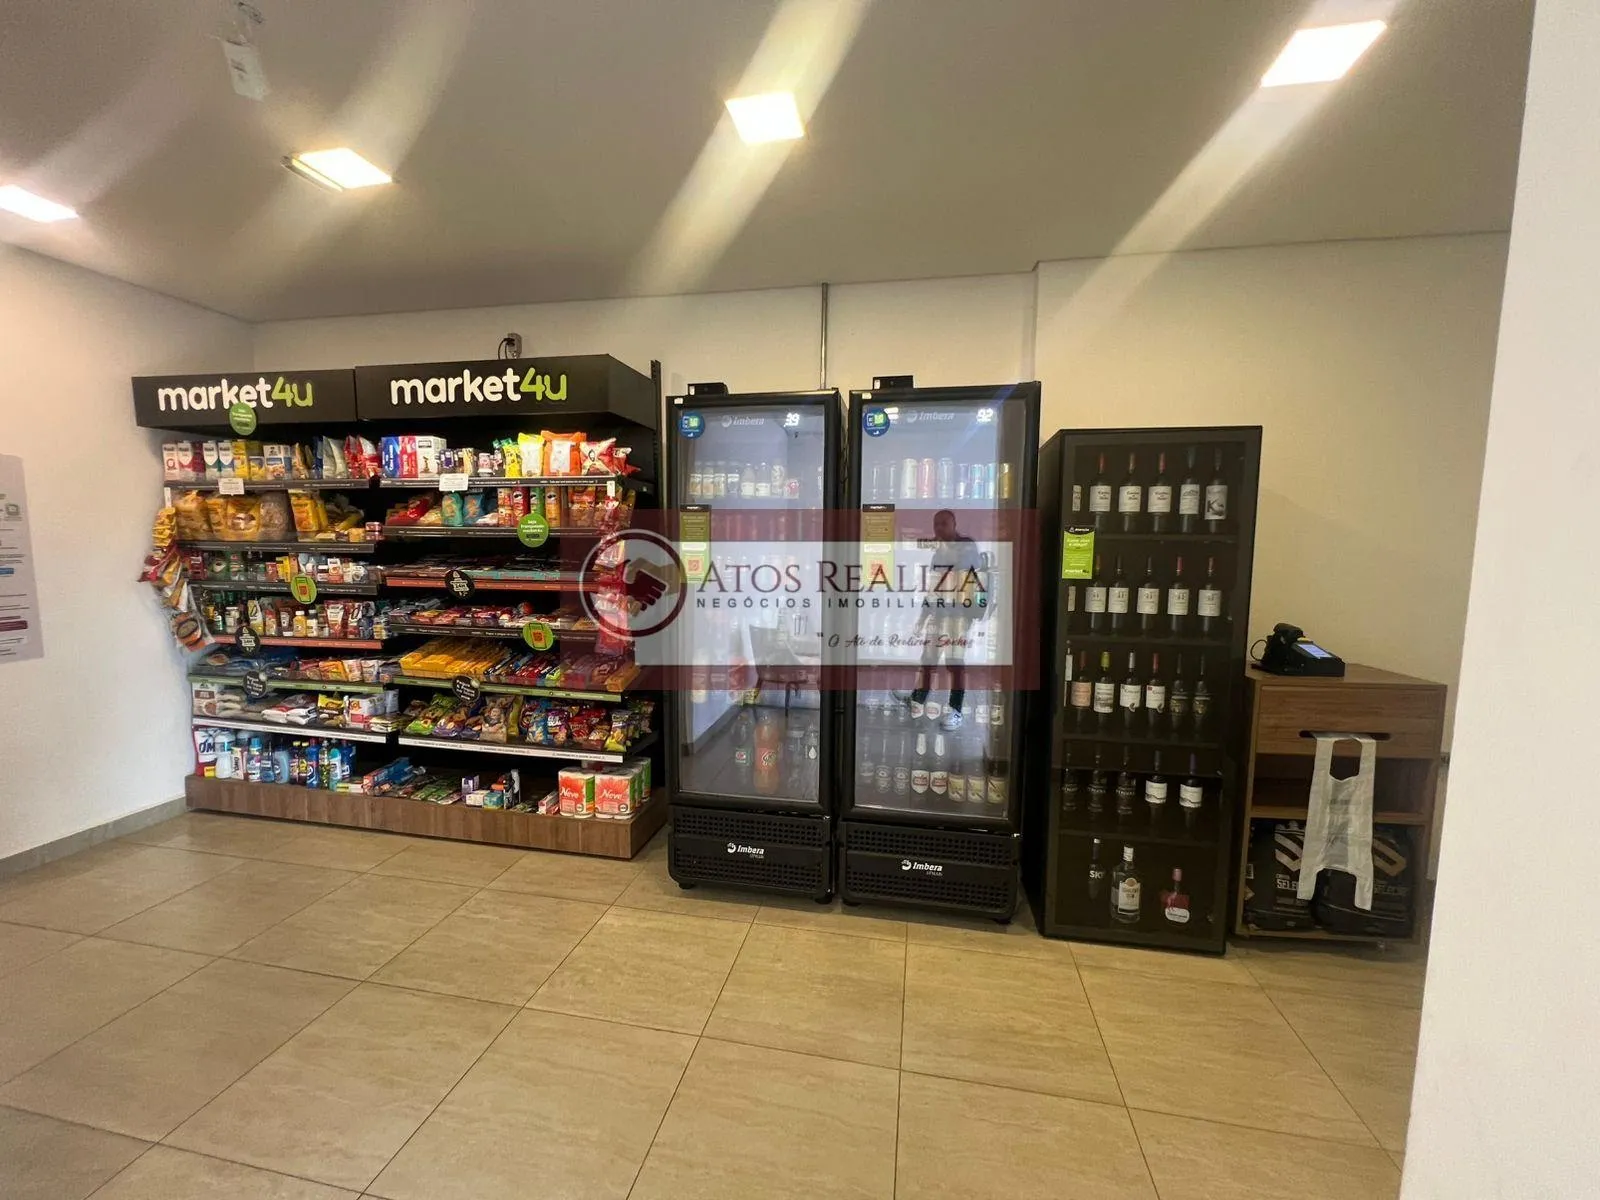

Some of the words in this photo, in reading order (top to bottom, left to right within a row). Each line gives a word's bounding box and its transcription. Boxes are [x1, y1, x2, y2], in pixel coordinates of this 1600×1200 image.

[158, 376, 313, 411] market4u
[390, 367, 567, 404] market4u
[737, 844, 765, 855] Imbera
[912, 861, 943, 872] Imbera
